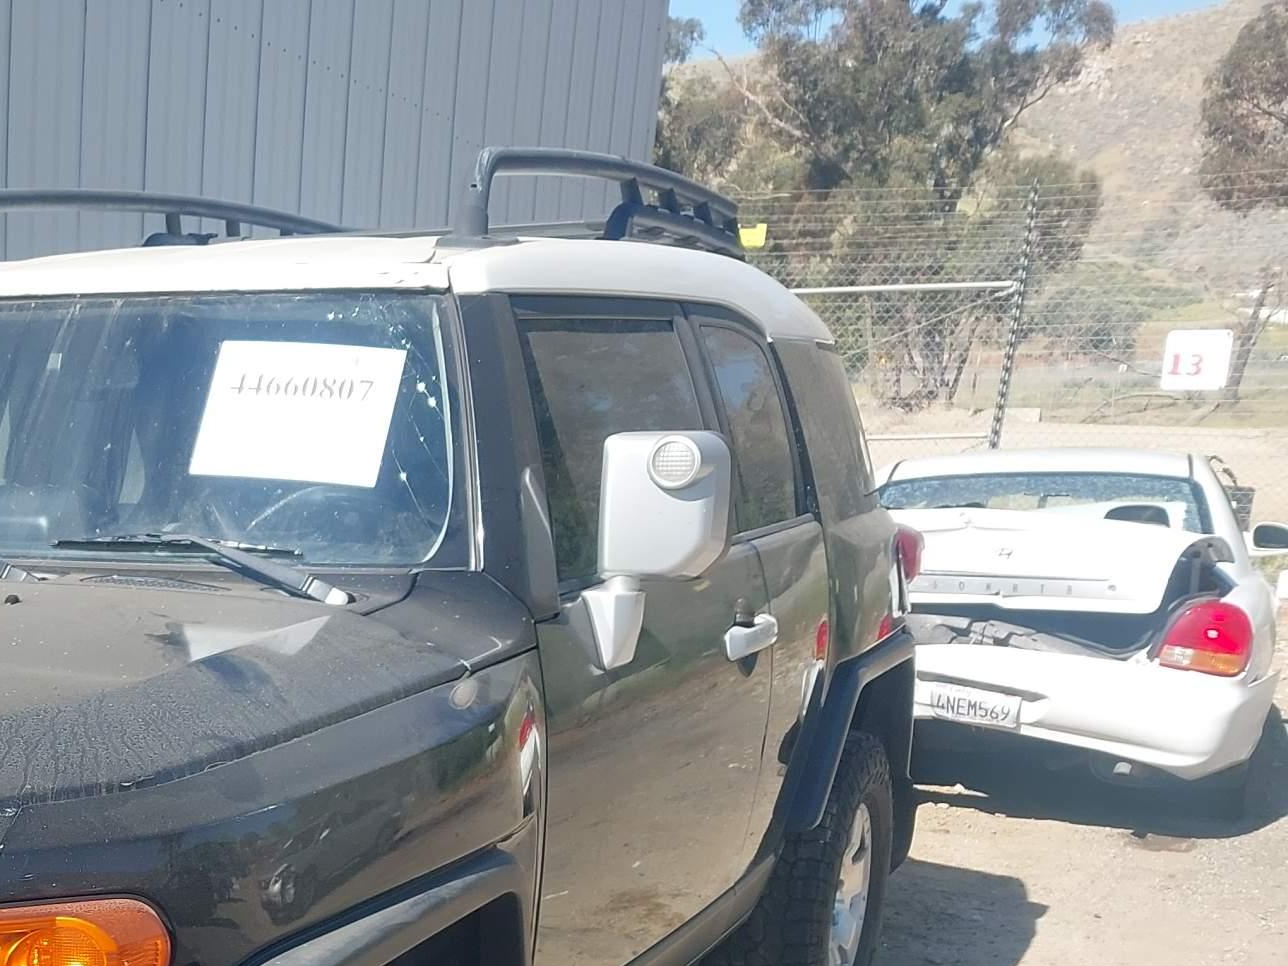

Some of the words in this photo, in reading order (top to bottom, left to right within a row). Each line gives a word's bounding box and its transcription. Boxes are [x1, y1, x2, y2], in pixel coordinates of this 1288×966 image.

[1167, 353, 1204, 377] 13
[230, 373, 375, 402] 44660807
[935, 693, 1011, 721] 4NEM569
